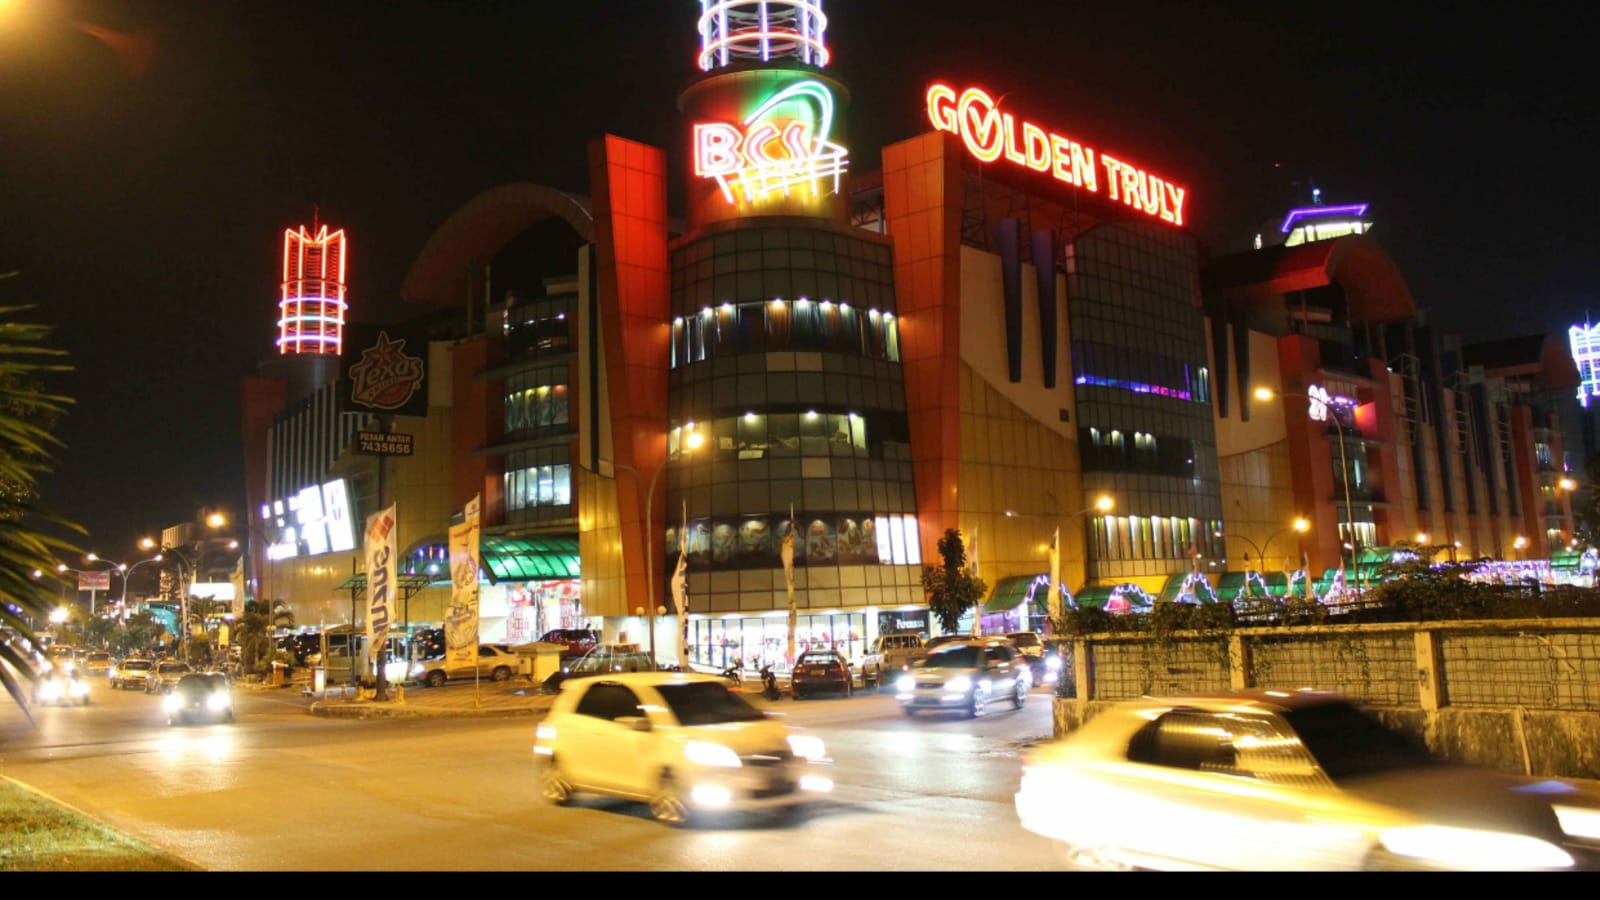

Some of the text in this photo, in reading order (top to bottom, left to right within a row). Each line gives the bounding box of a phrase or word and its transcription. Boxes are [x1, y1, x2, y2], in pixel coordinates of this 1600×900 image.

[693, 119, 814, 176] BCS
[926, 83, 1185, 226] GOLDEN TRULY
[350, 357, 422, 396] Texas
[361, 442, 411, 454] 7435656
